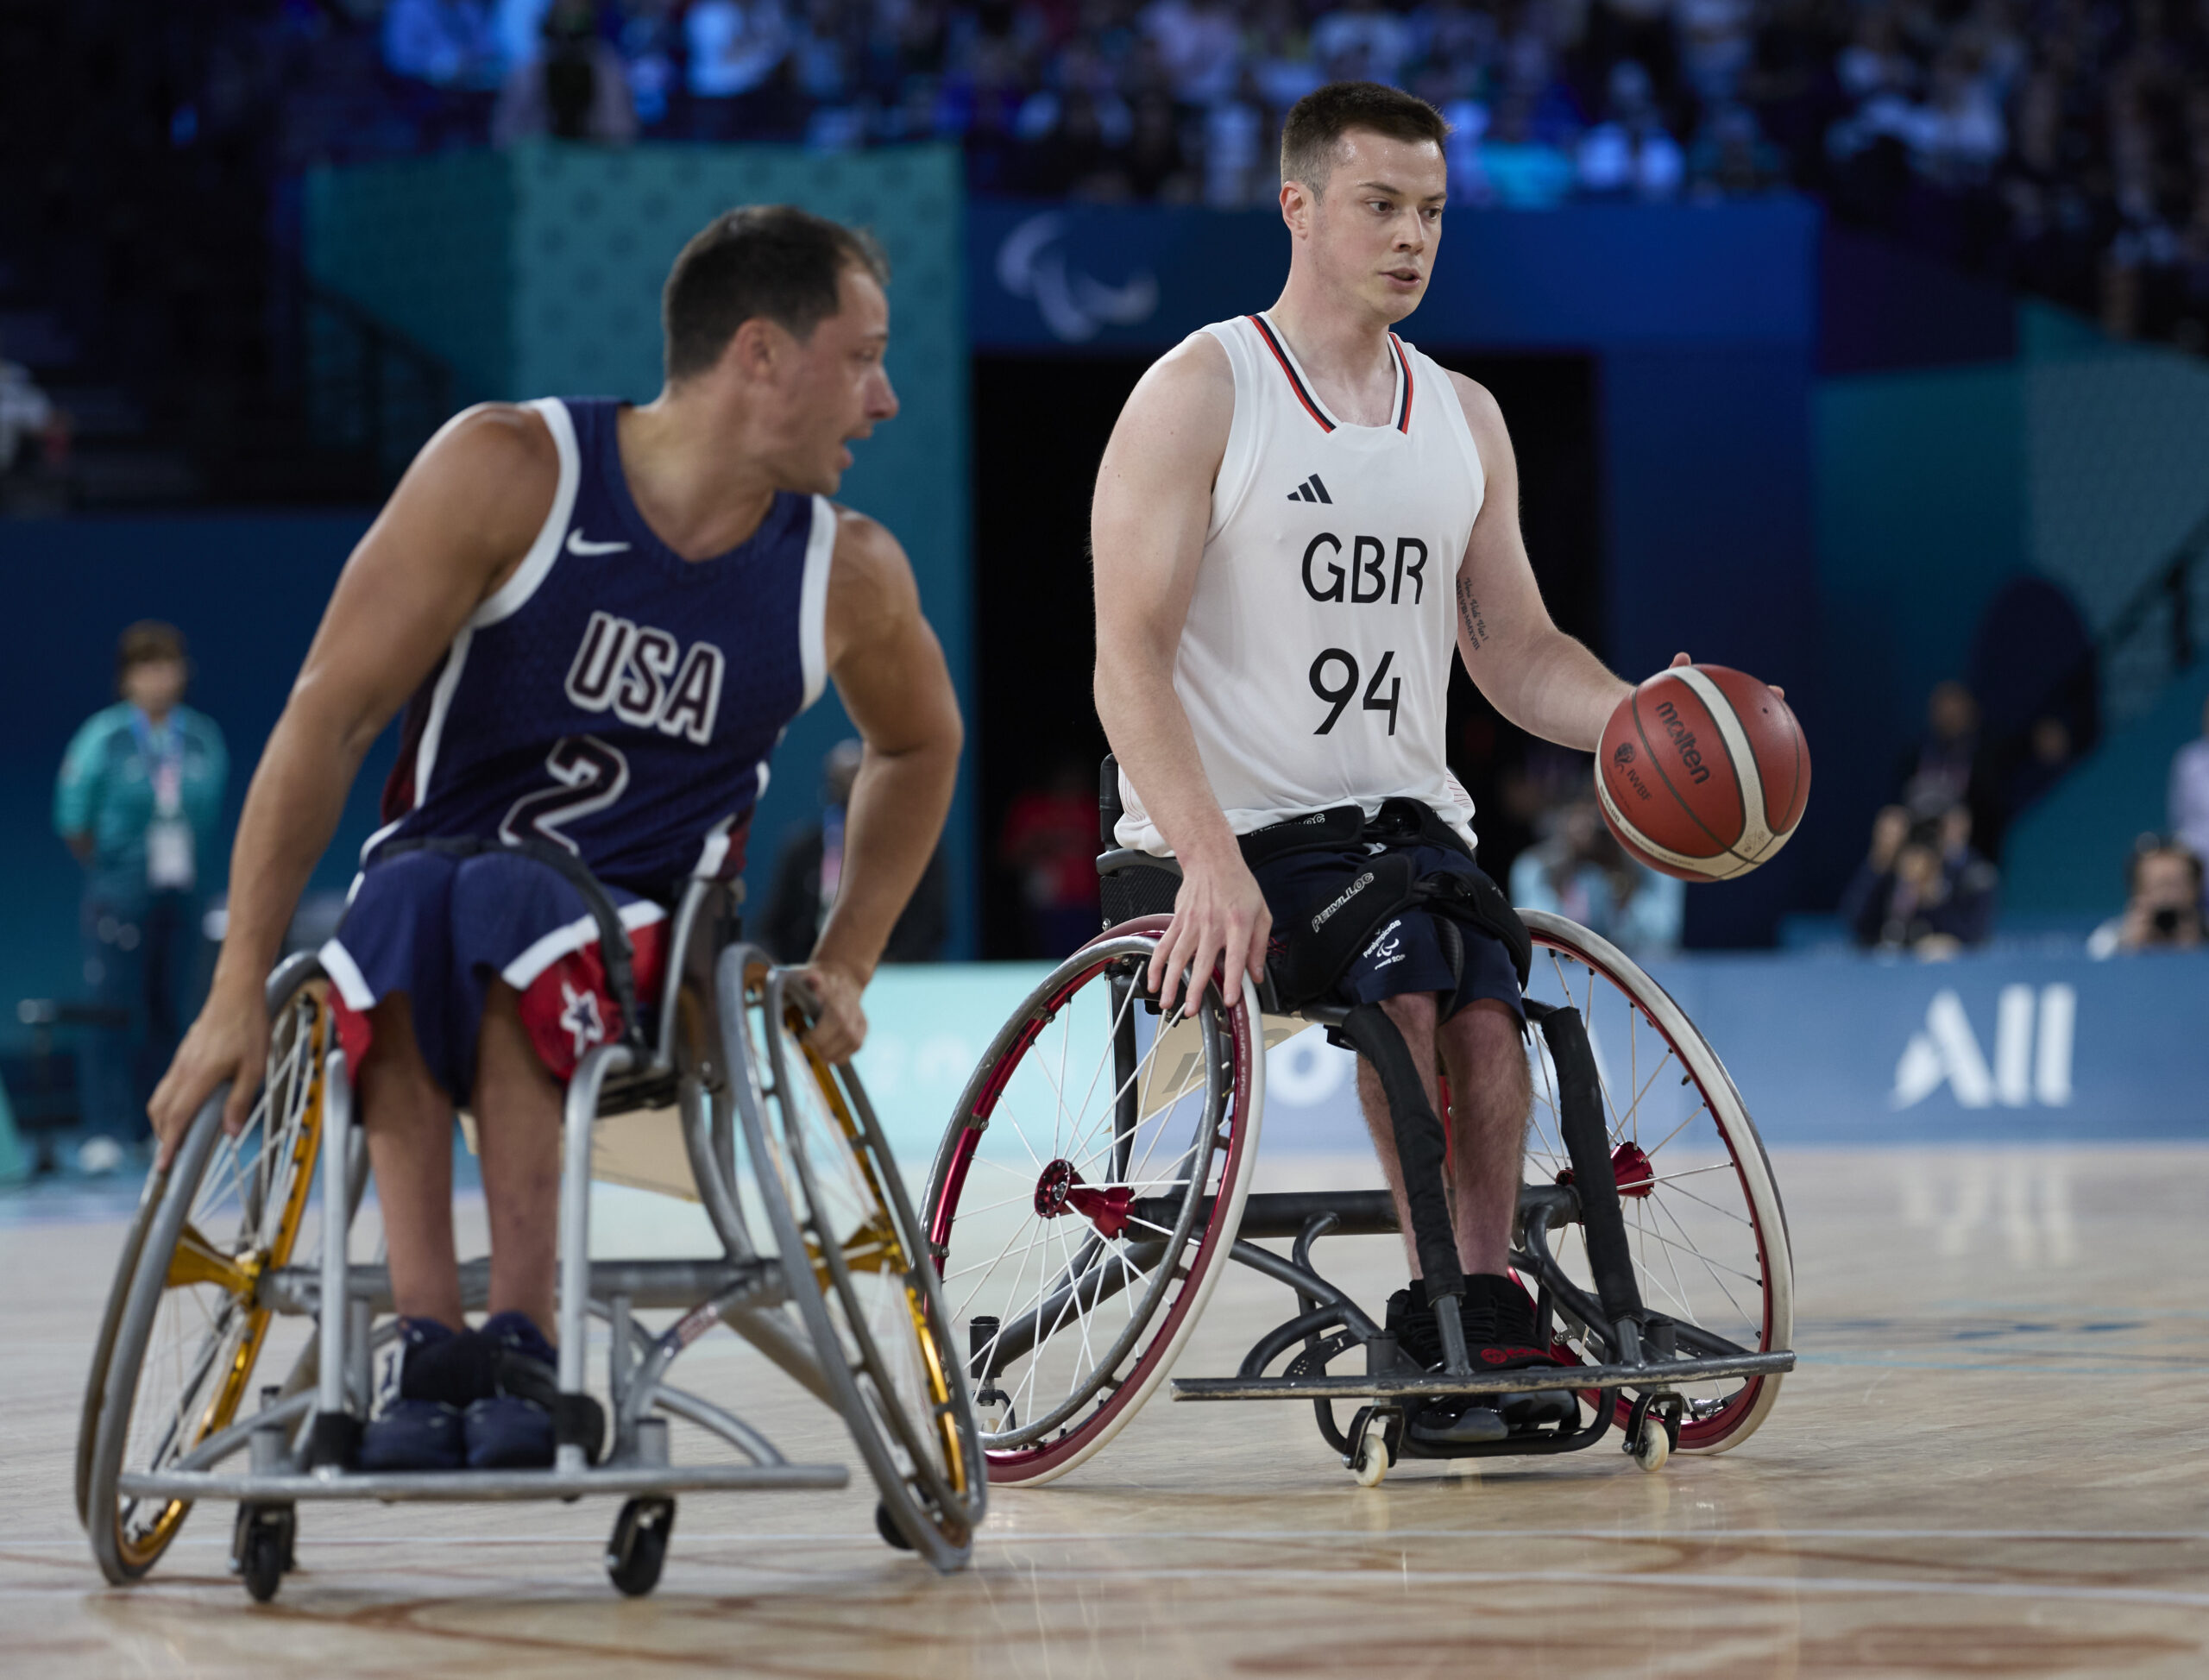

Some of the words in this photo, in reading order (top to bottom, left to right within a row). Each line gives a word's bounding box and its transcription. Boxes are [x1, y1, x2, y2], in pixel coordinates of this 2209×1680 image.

[1302, 532, 1428, 605] GBR
[564, 610, 726, 746] USA
[1309, 648, 1401, 736] 94
[1627, 768, 1652, 801] IWBF
[1655, 701, 1710, 784] molten
[499, 734, 630, 857] 2
